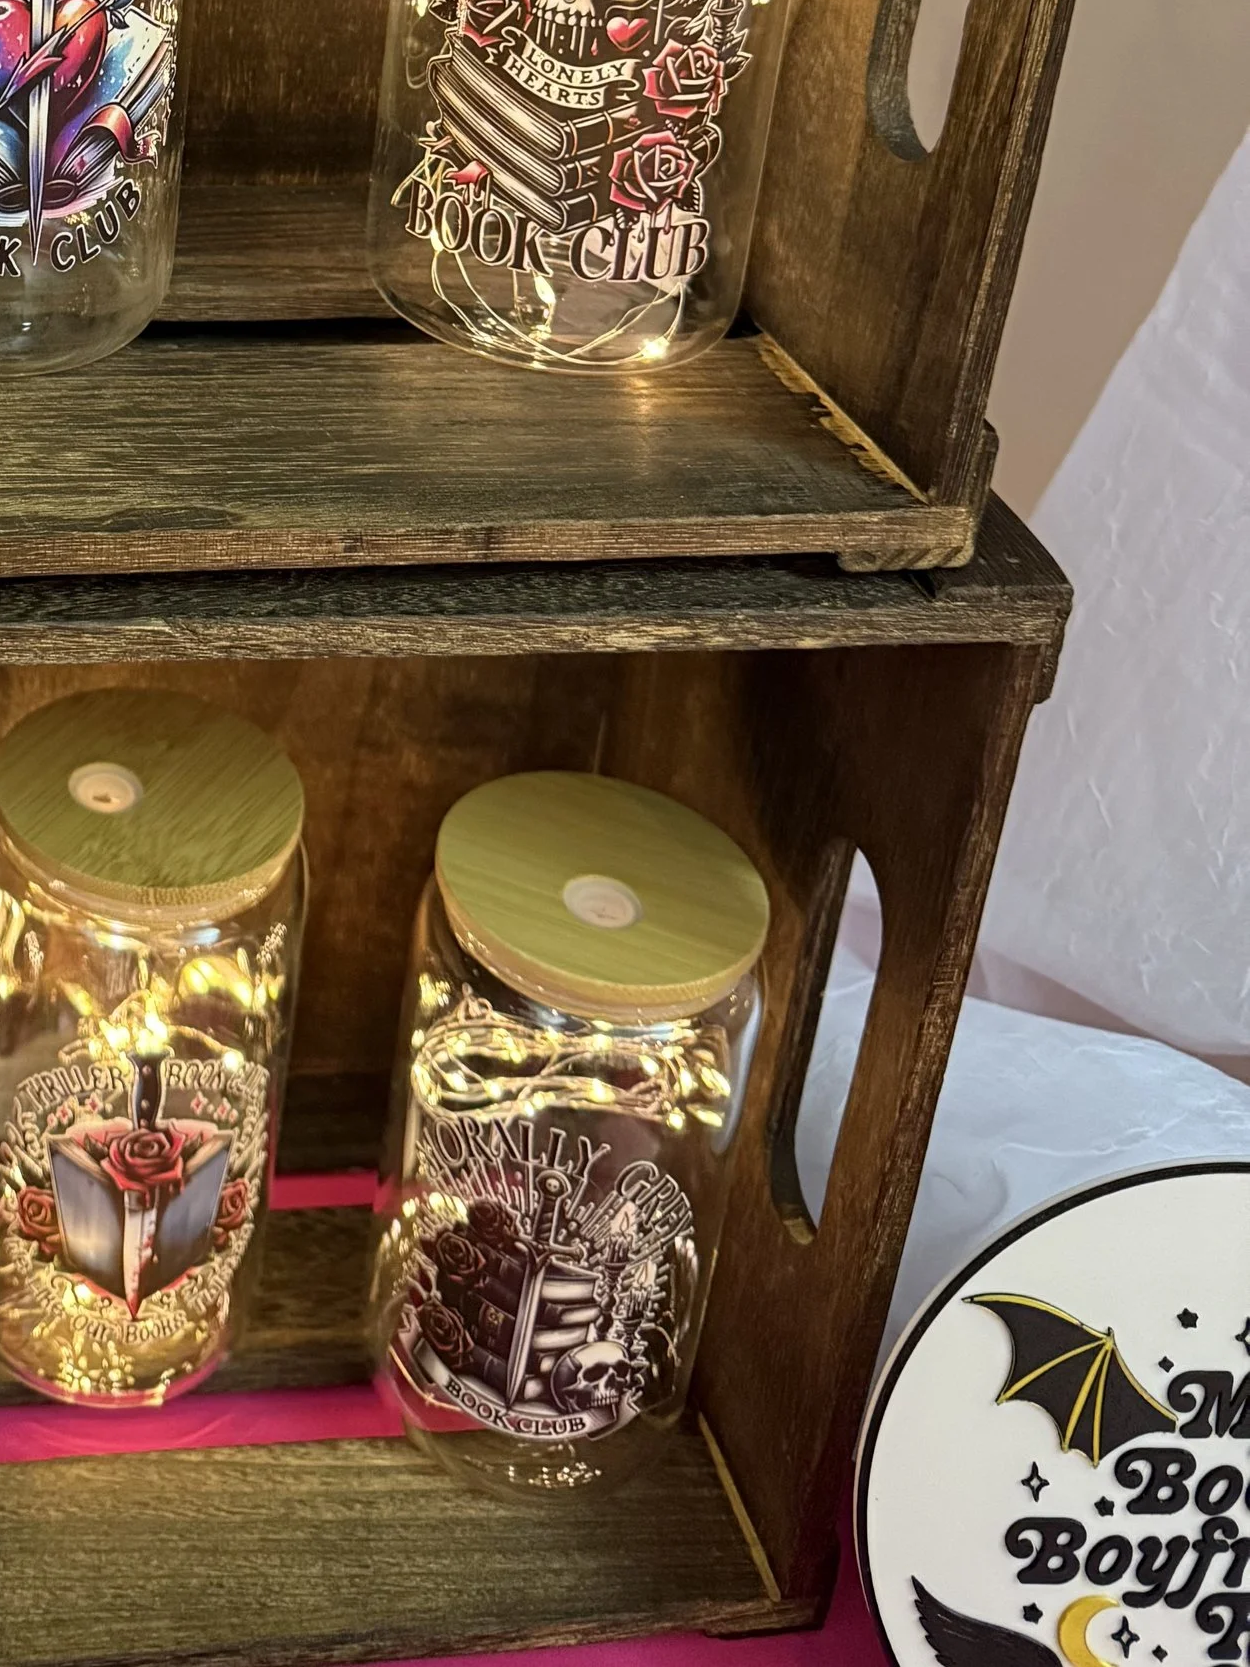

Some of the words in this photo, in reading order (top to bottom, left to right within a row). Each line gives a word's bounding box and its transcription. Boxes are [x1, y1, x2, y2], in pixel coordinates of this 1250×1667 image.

[507, 57, 602, 107] HEARTS
[524, 47, 628, 85] LONELY
[49, 177, 143, 274] CLUB
[404, 177, 553, 277] BOOK
[570, 218, 712, 284] CLUB
[444, 1375, 515, 1431] BOOK
[516, 1416, 586, 1436] CLUB
[1115, 1447, 1250, 1516] Bo
